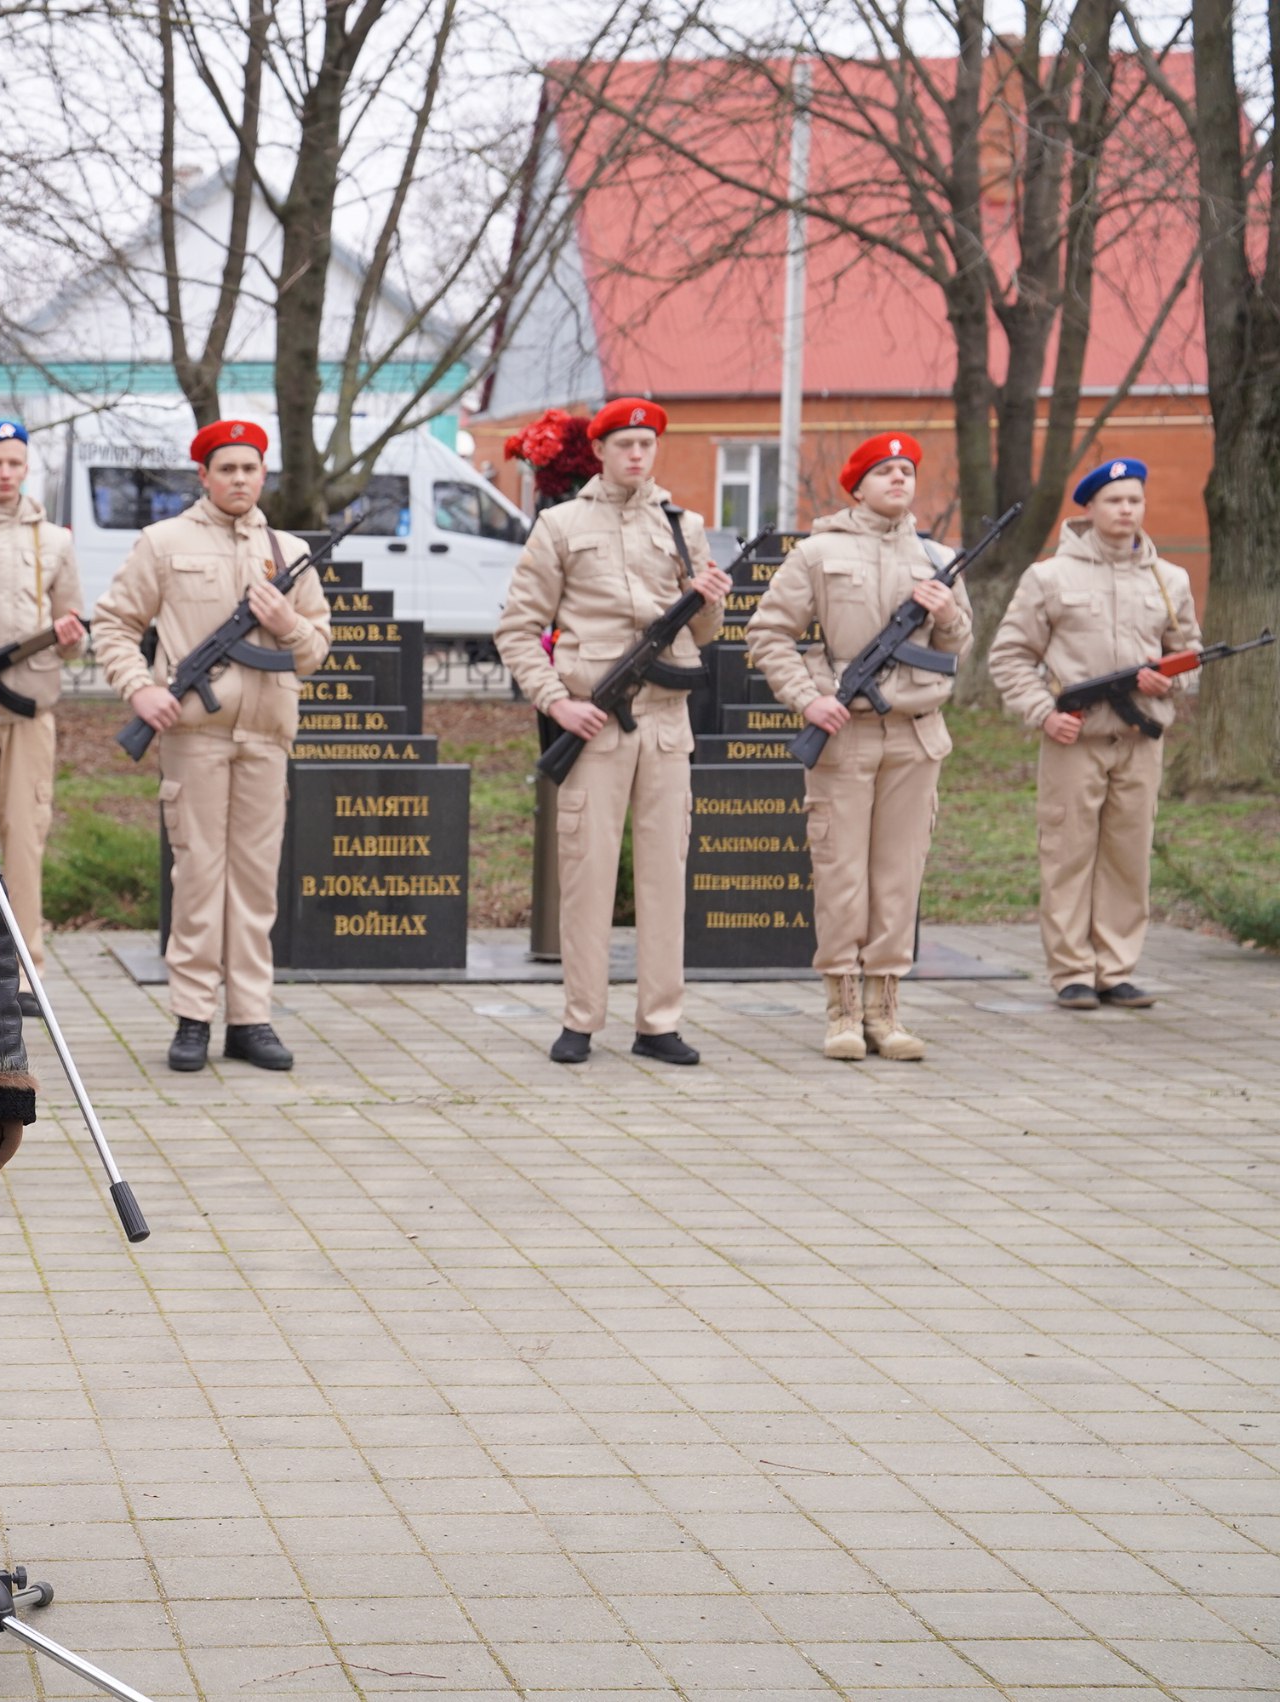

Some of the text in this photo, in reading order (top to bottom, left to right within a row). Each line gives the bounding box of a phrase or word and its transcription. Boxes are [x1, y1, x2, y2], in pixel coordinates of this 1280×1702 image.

[352, 594, 373, 611] М.
[368, 624, 383, 641] В.
[386, 624, 401, 641] Е.
[344, 654, 361, 670] А.
[316, 683, 333, 700] С.
[336, 683, 352, 700] В.
[298, 712, 388, 730] АНЕВ П. Ю.
[383, 743, 400, 759] А.
[402, 743, 419, 759] А.
[335, 796, 429, 817] ПАМЯТИ
[696, 797, 786, 815] КОНДАКОВ
[333, 835, 431, 857] ПАВШИХ
[699, 835, 780, 852] ХАКИМОВ
[782, 836, 799, 852] А.
[302, 875, 461, 896] В ЛОКАЛЬНЫХ
[693, 874, 785, 890] ШЕВЧЕНКО
[787, 873, 804, 890] В.
[334, 910, 427, 935] ВОЙНАХ
[706, 911, 809, 928] ШИПКО В. А.
